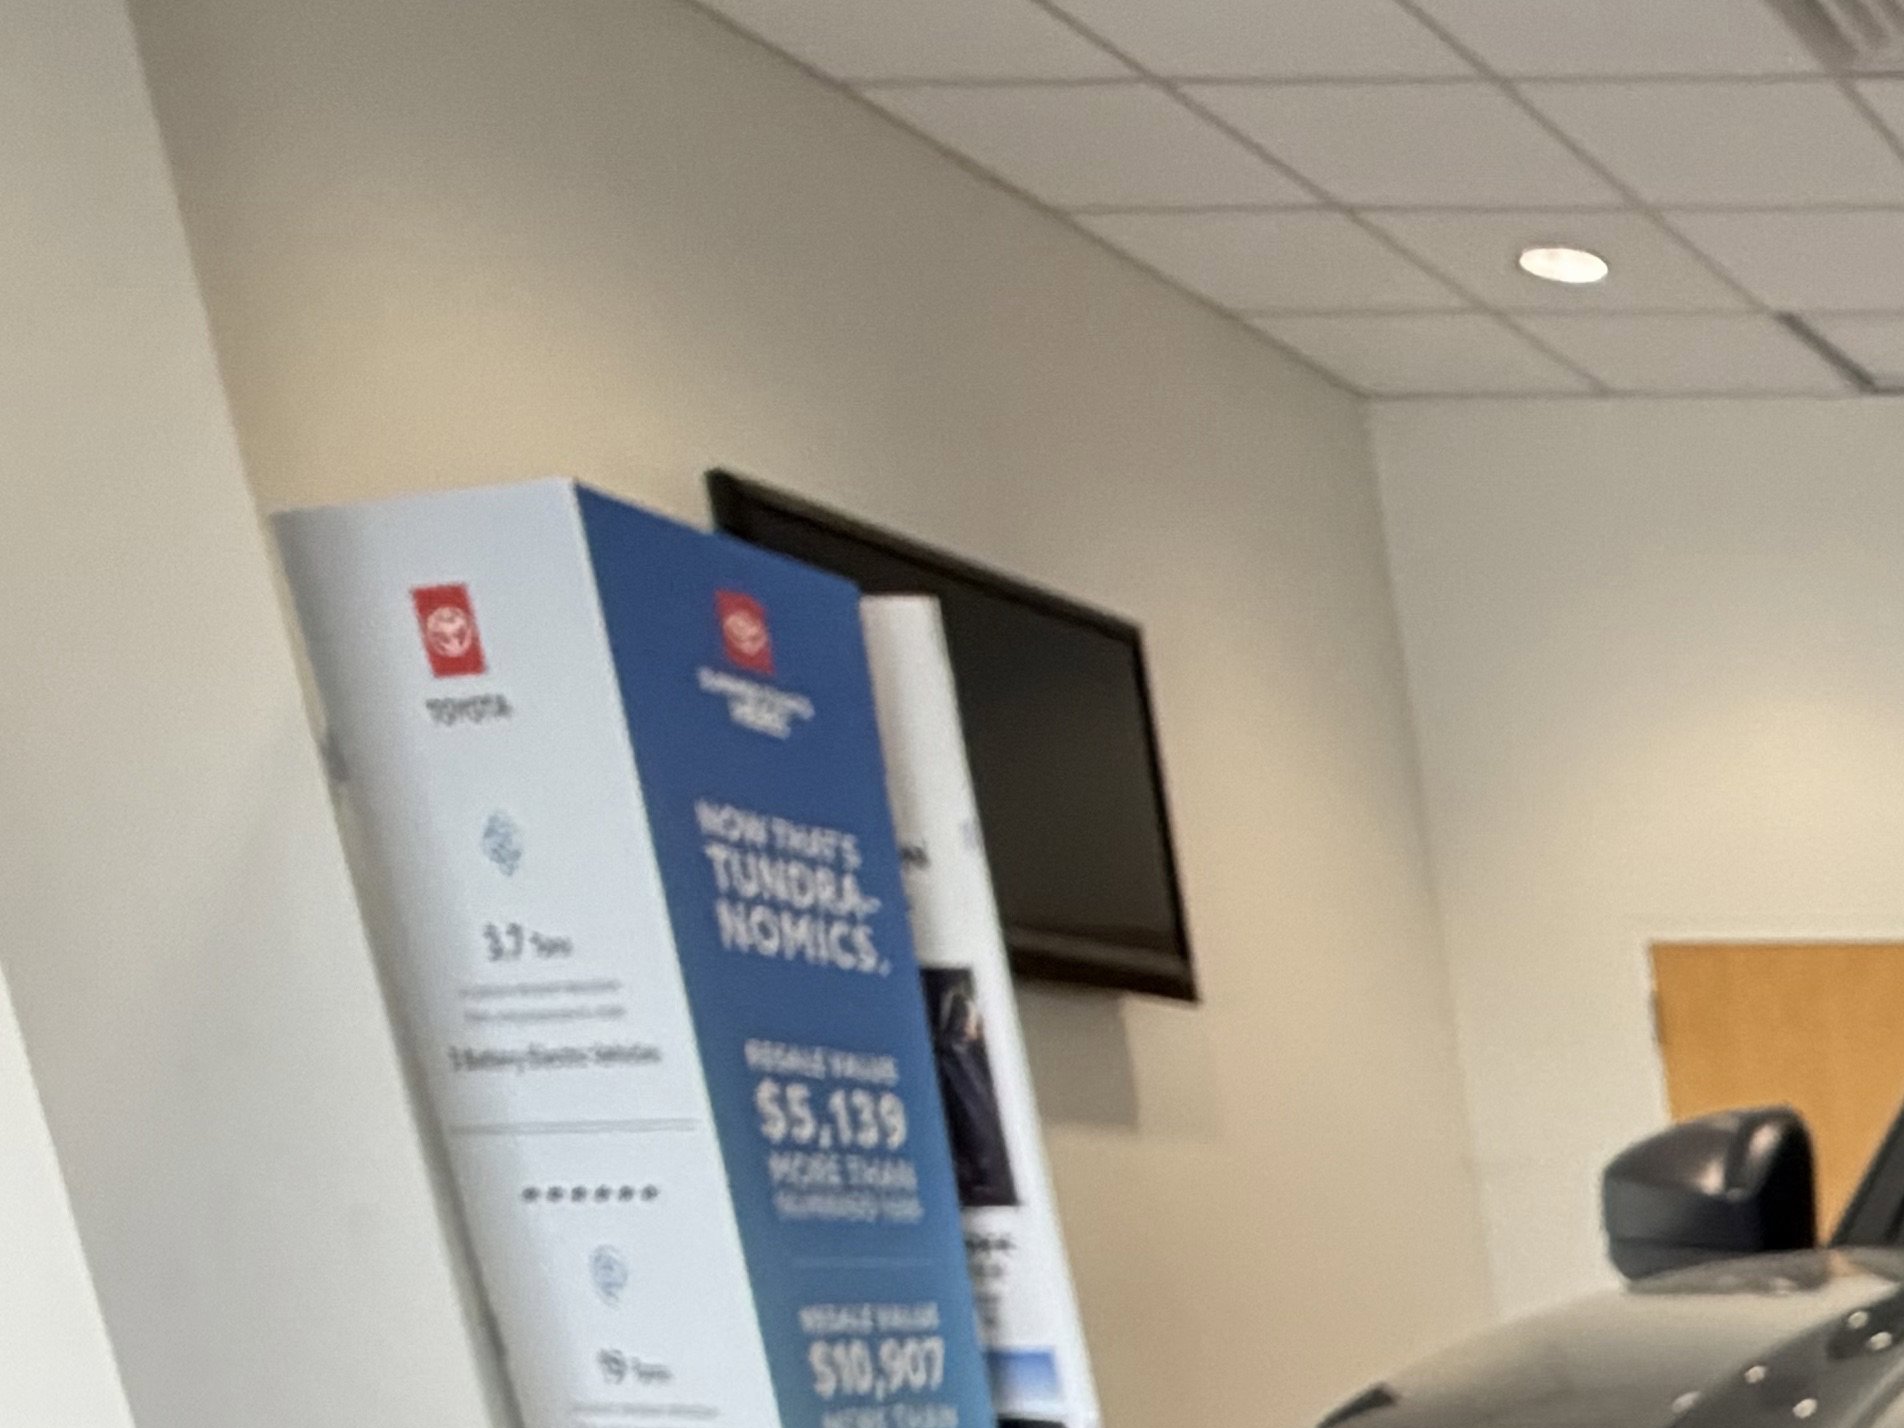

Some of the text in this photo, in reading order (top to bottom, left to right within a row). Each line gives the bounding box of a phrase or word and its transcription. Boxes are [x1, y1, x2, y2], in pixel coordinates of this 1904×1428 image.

[695, 798, 769, 846] NOW
[769, 816, 864, 870] THAT'S
[714, 897, 891, 976] NOMICS.
[756, 1077, 908, 1150] $5,139
[768, 1152, 919, 1194] MORE THAN
[808, 1334, 945, 1400] $10,907
